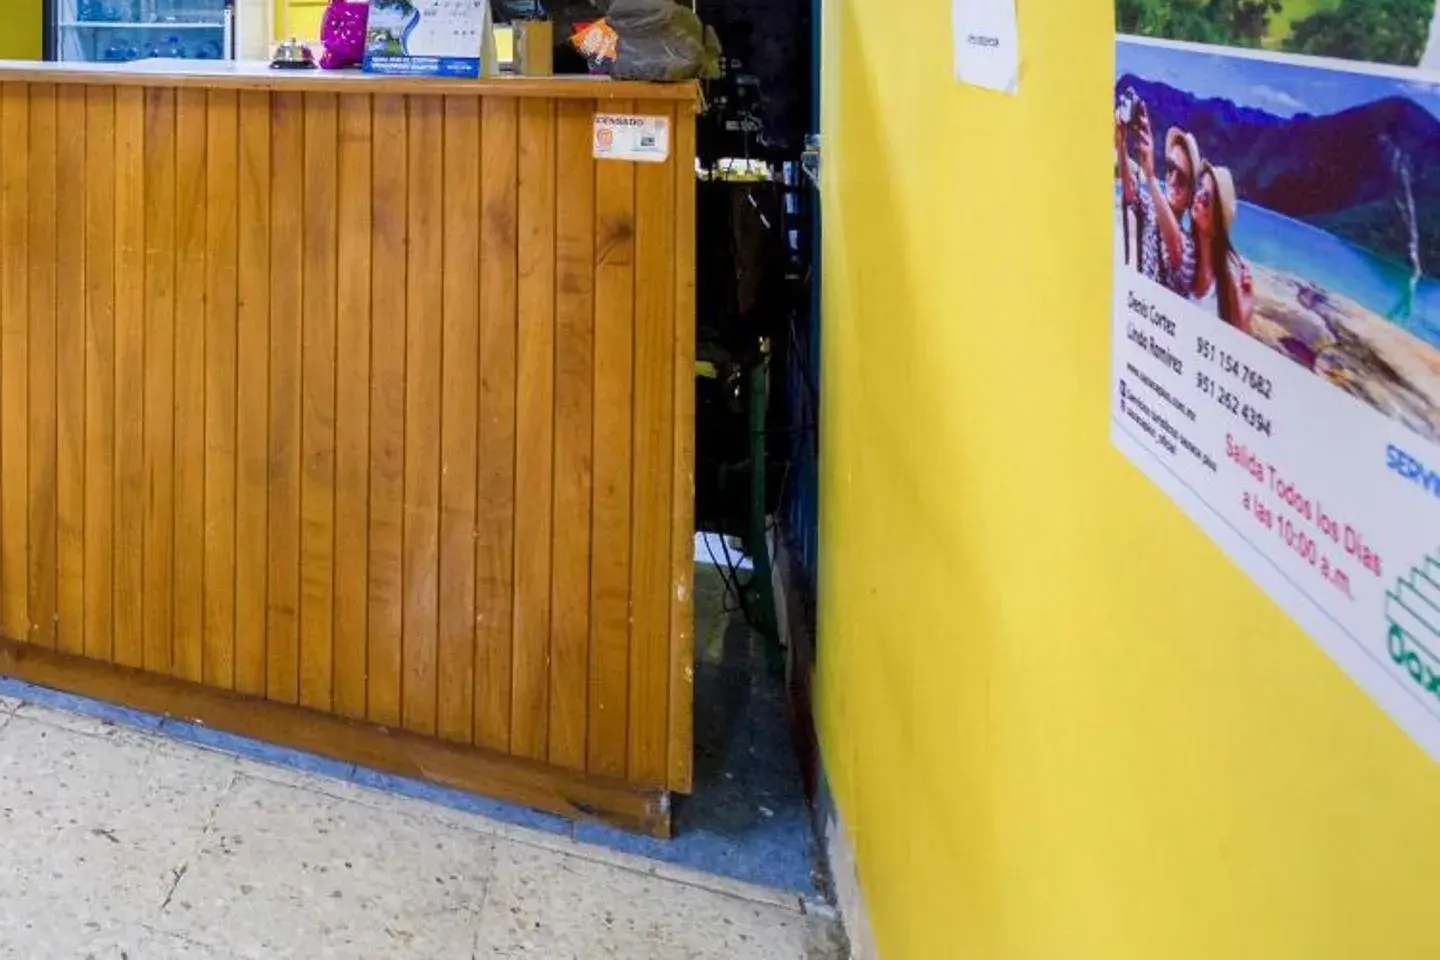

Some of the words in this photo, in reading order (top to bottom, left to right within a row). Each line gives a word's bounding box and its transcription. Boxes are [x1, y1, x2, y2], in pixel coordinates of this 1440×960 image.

[1225, 432, 1264, 482] Salida
[1267, 463, 1312, 521] Todos
[1316, 500, 1339, 544] los
[1253, 494, 1272, 530] las
[1277, 514, 1317, 566] 10:00
